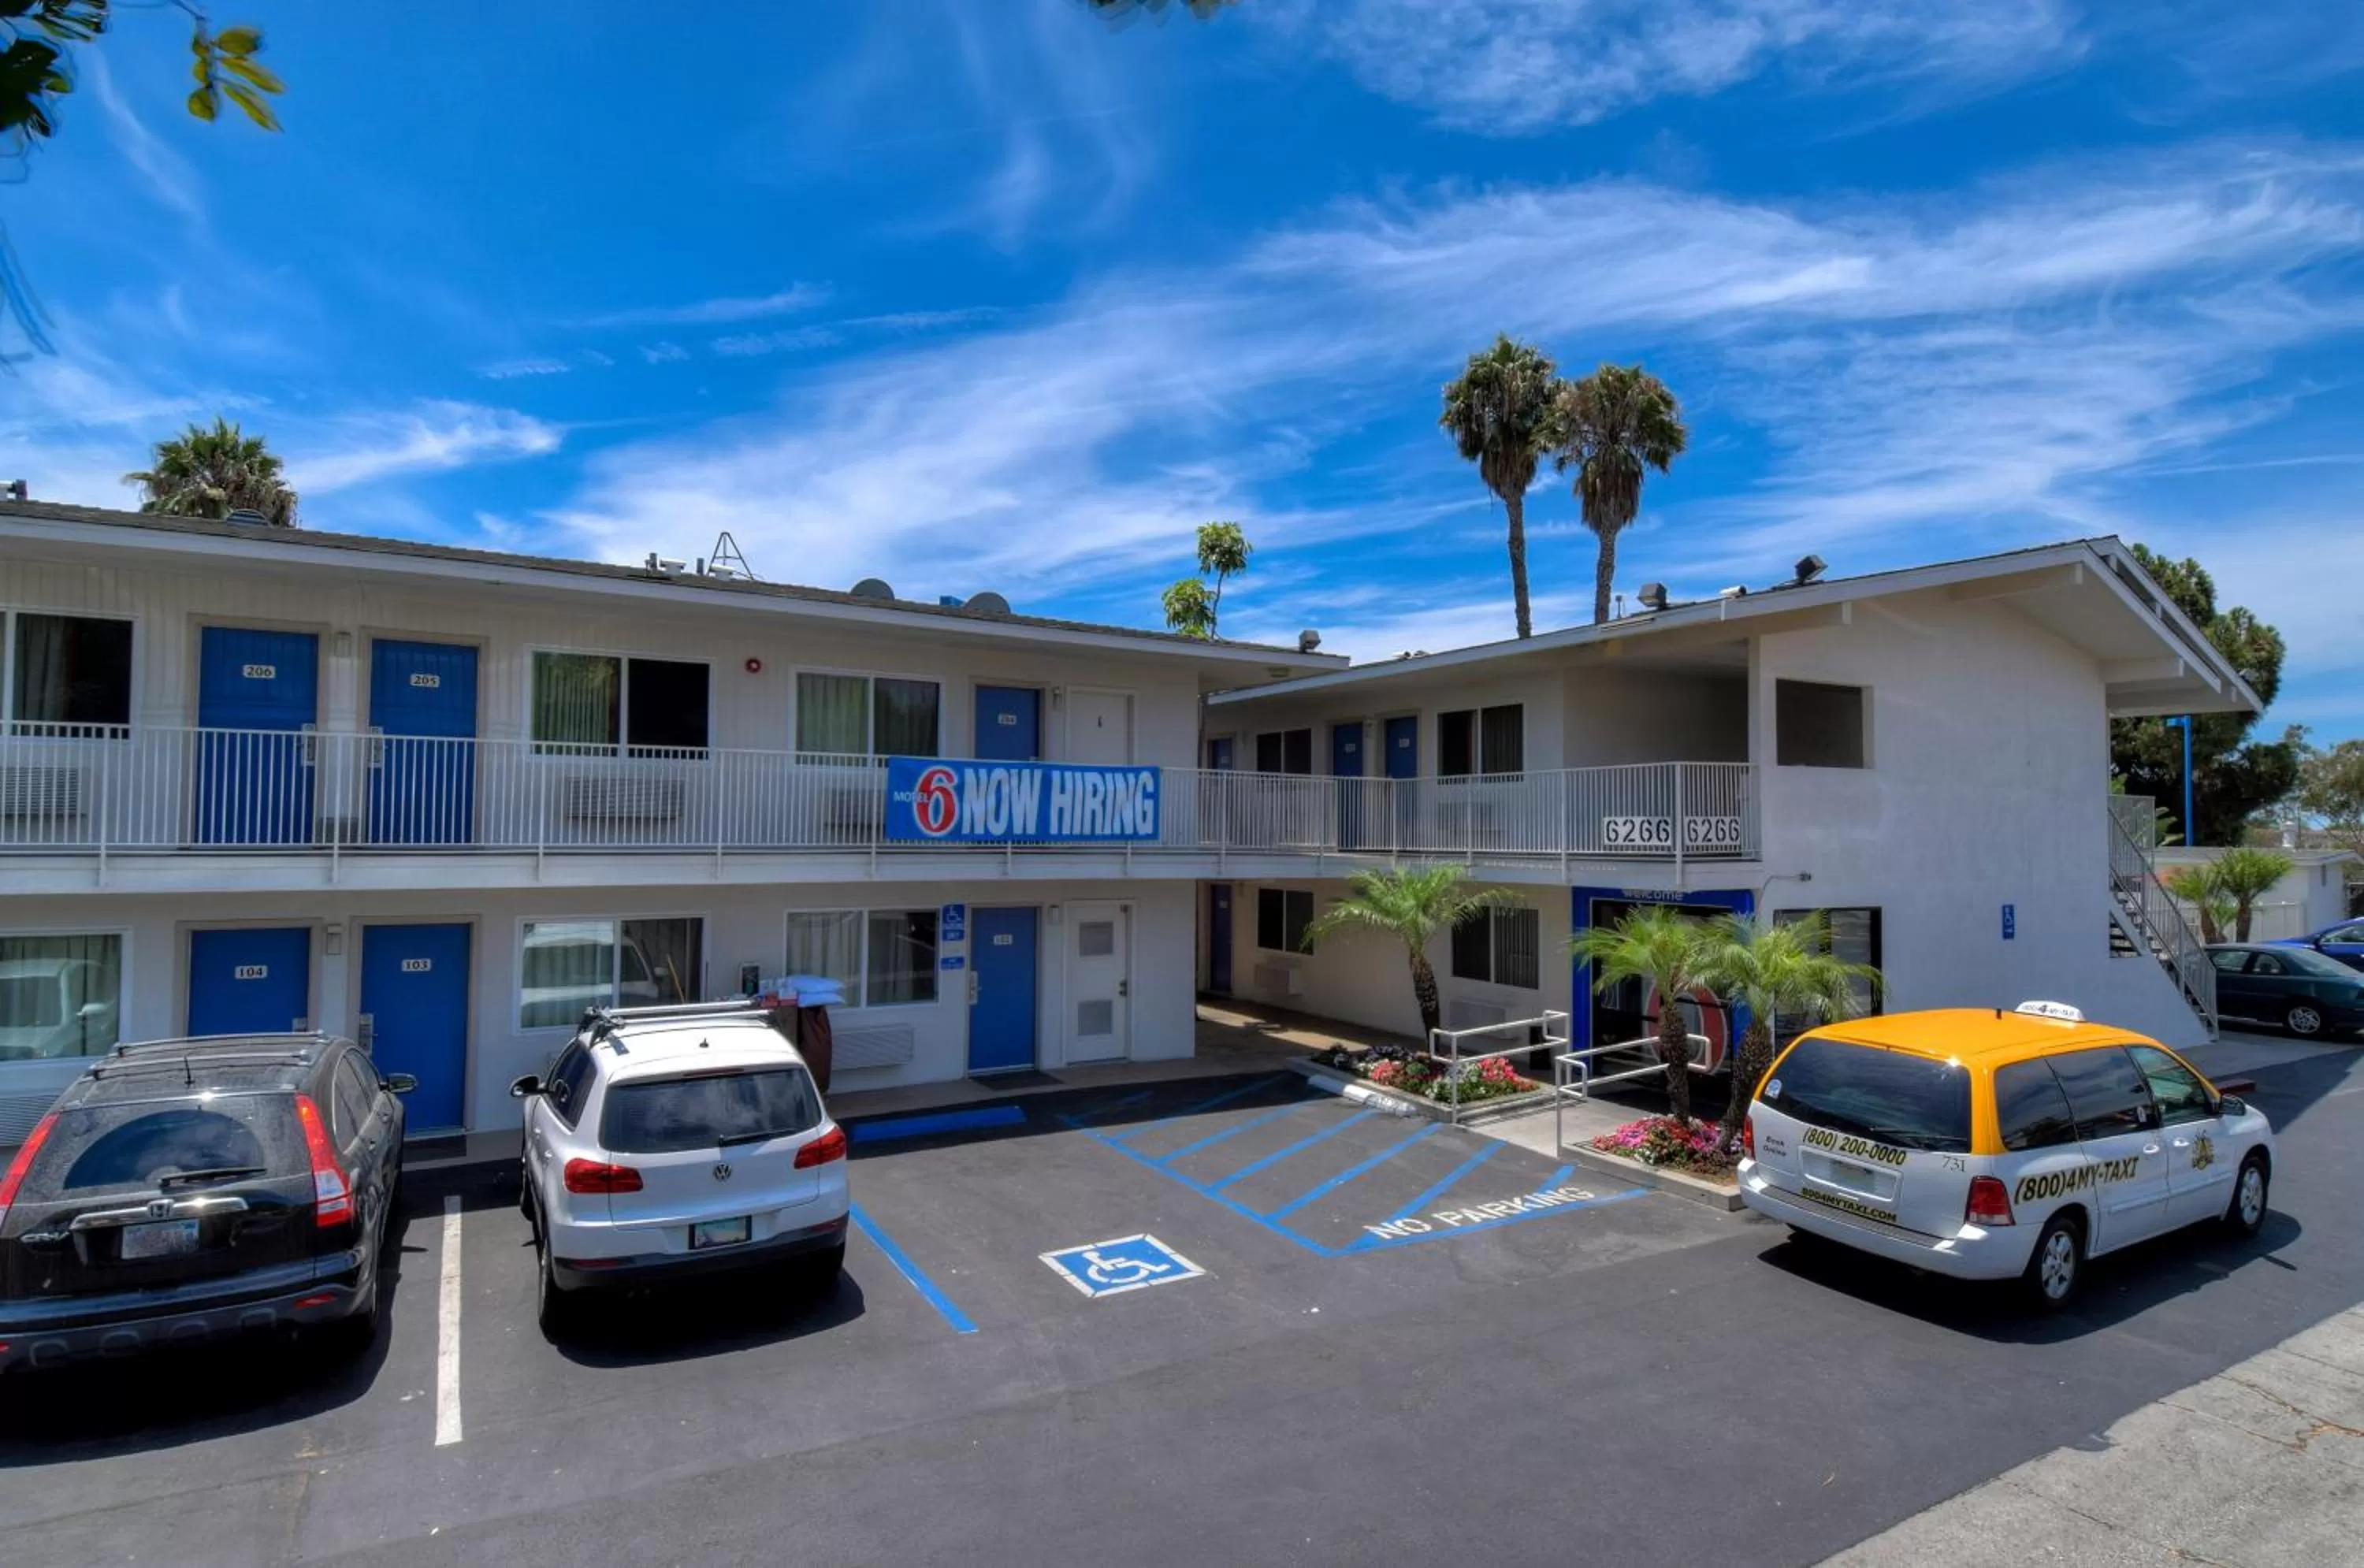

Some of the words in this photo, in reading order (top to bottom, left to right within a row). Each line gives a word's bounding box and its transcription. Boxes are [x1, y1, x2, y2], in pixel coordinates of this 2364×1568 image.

[247, 666, 273, 677] 206
[413, 674, 437, 686] 205
[894, 790, 931, 802] MOTEL
[914, 767, 960, 837] 6
[961, 767, 1043, 836] NOW
[1049, 770, 1154, 835] HIRING
[1605, 818, 1671, 843] 6266
[1686, 818, 1740, 843] 6266
[239, 967, 264, 977] 104
[1802, 1127, 1837, 1152] (800)
[1838, 1136, 1907, 1165] 200-0000
[1941, 1155, 1966, 1172] 731
[2013, 1156, 2139, 1205] (800)4MY-TAXI
[1362, 1218, 1433, 1239] NO
[1431, 1187, 1595, 1227] PARKING
